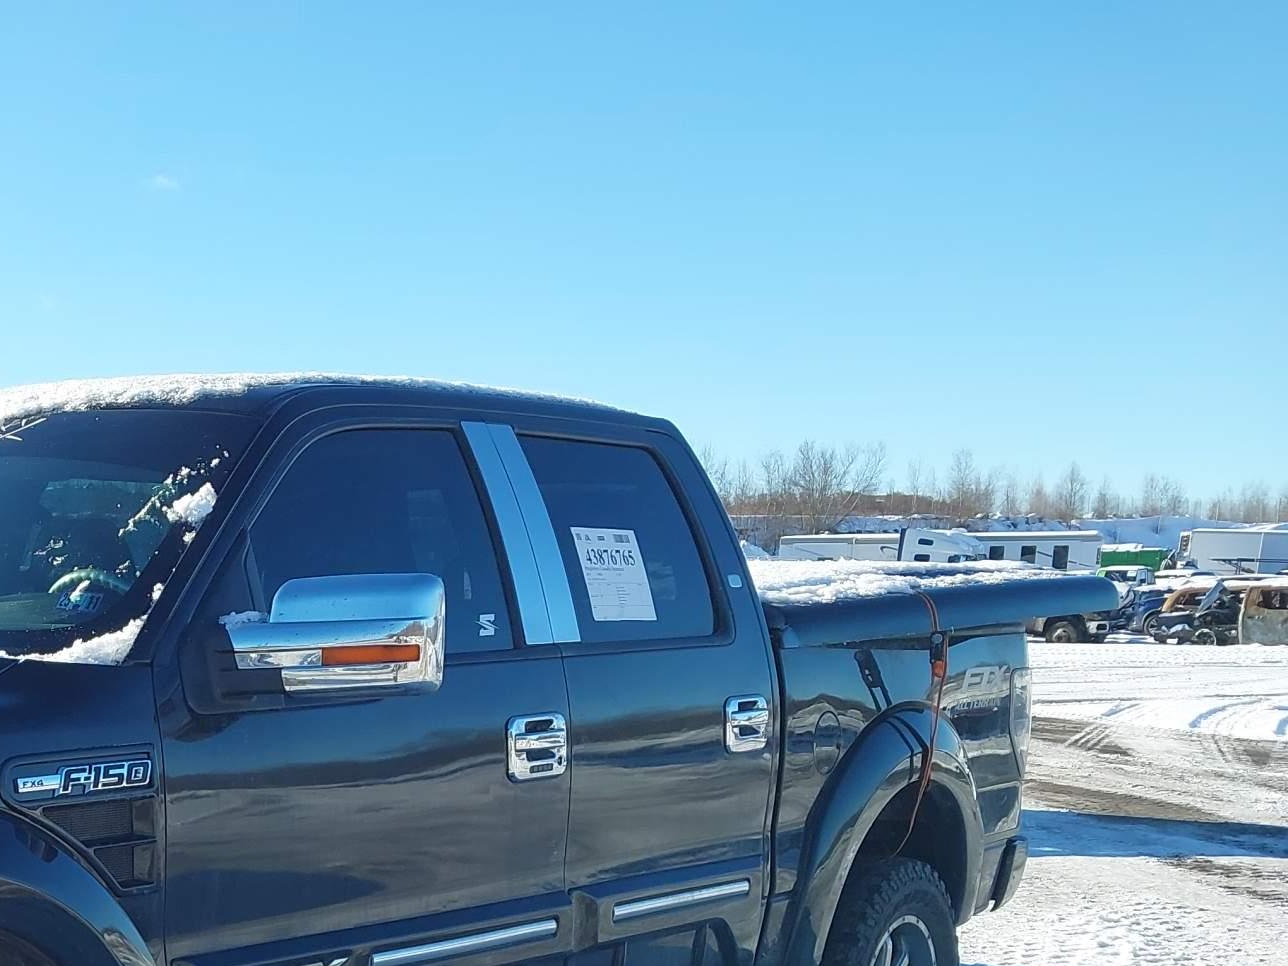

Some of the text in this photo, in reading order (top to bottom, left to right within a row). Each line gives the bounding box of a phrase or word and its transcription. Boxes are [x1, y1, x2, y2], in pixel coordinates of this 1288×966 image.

[585, 548, 636, 567] 43876765
[22, 759, 152, 795] FX4 F-150
